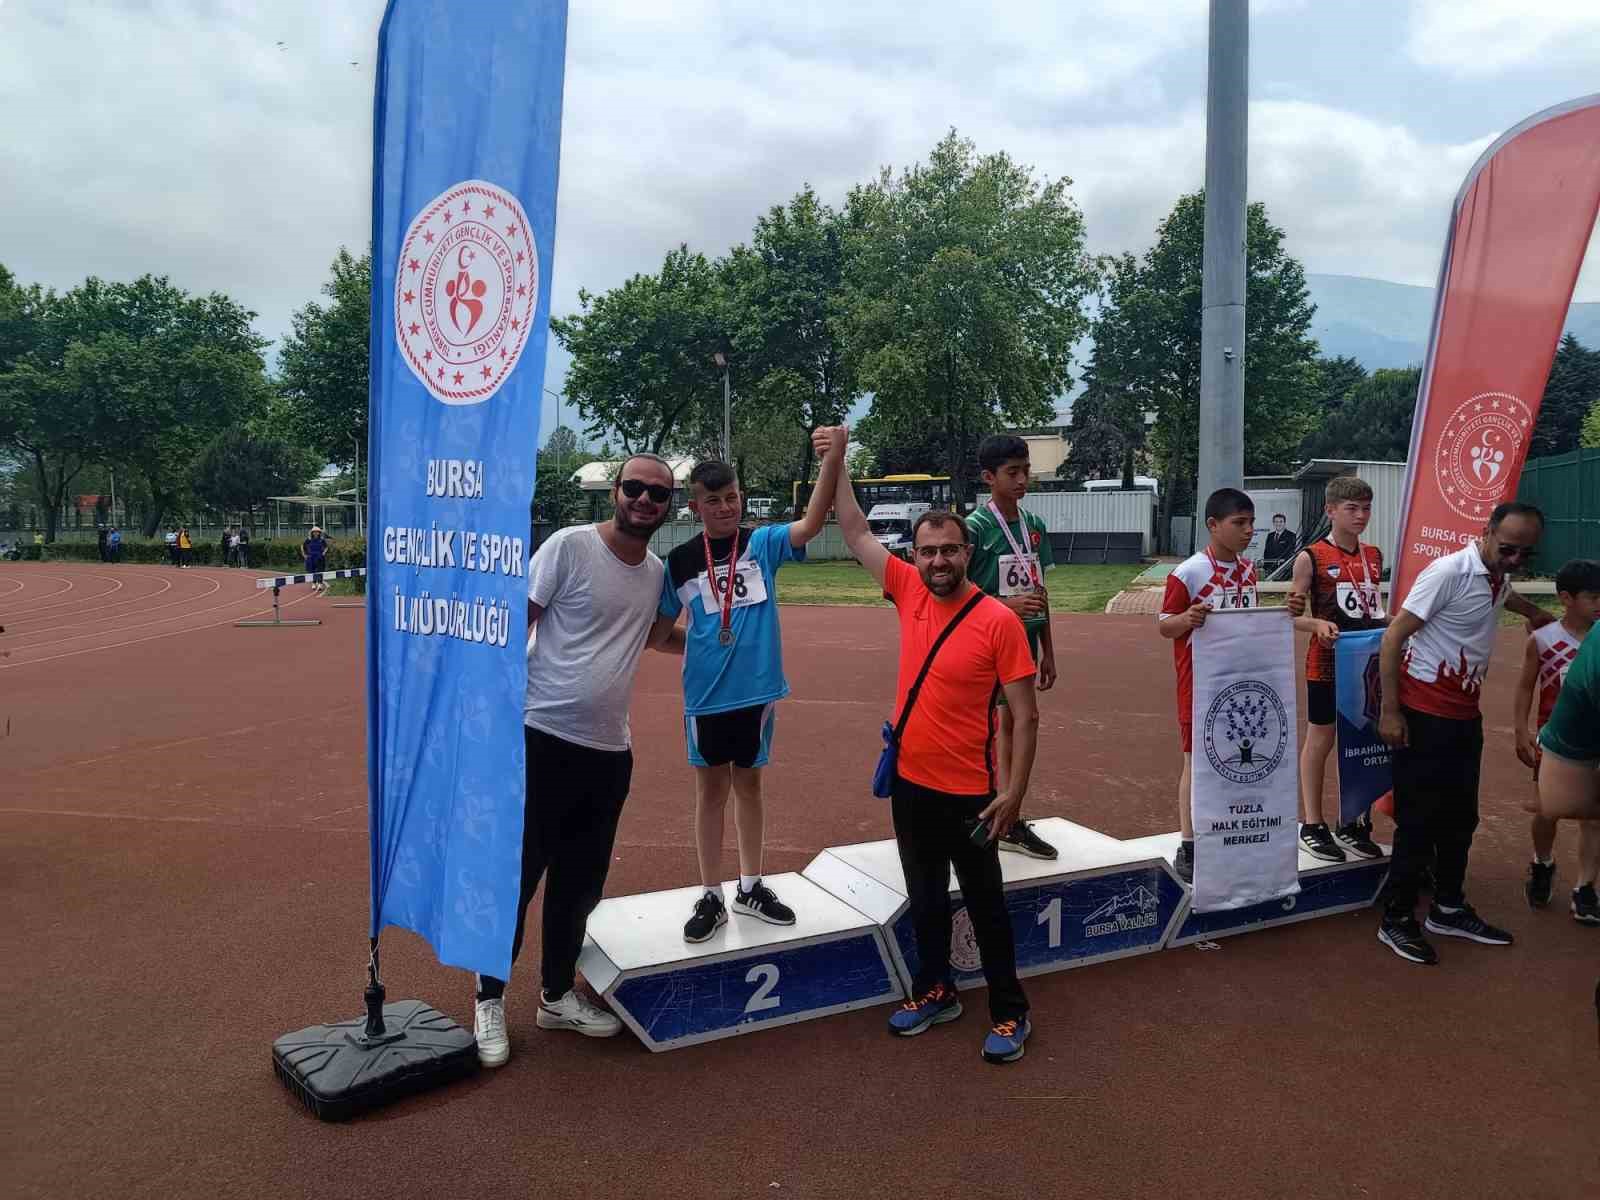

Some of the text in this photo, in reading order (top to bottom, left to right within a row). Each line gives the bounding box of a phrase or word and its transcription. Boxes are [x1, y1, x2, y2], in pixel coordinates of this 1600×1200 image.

[492, 241, 506, 257] VE
[426, 459, 484, 499] BURSA
[1421, 526, 1484, 545] BURSA GEN
[383, 520, 524, 577] GENÇLİK VE SPOR
[1412, 543, 1441, 558] SPOR
[394, 585, 407, 632] İL
[1345, 744, 1385, 758] İBRAHİM
[1363, 755, 1388, 767] ORTA
[1228, 803, 1264, 815] TUZLA
[1211, 815, 1281, 832] HALK EĞİTİMİ
[1223, 831, 1270, 846] MERKEZİ
[1038, 898, 1061, 949] 1
[1085, 921, 1119, 938] BURSA
[744, 964, 780, 1014] 2
